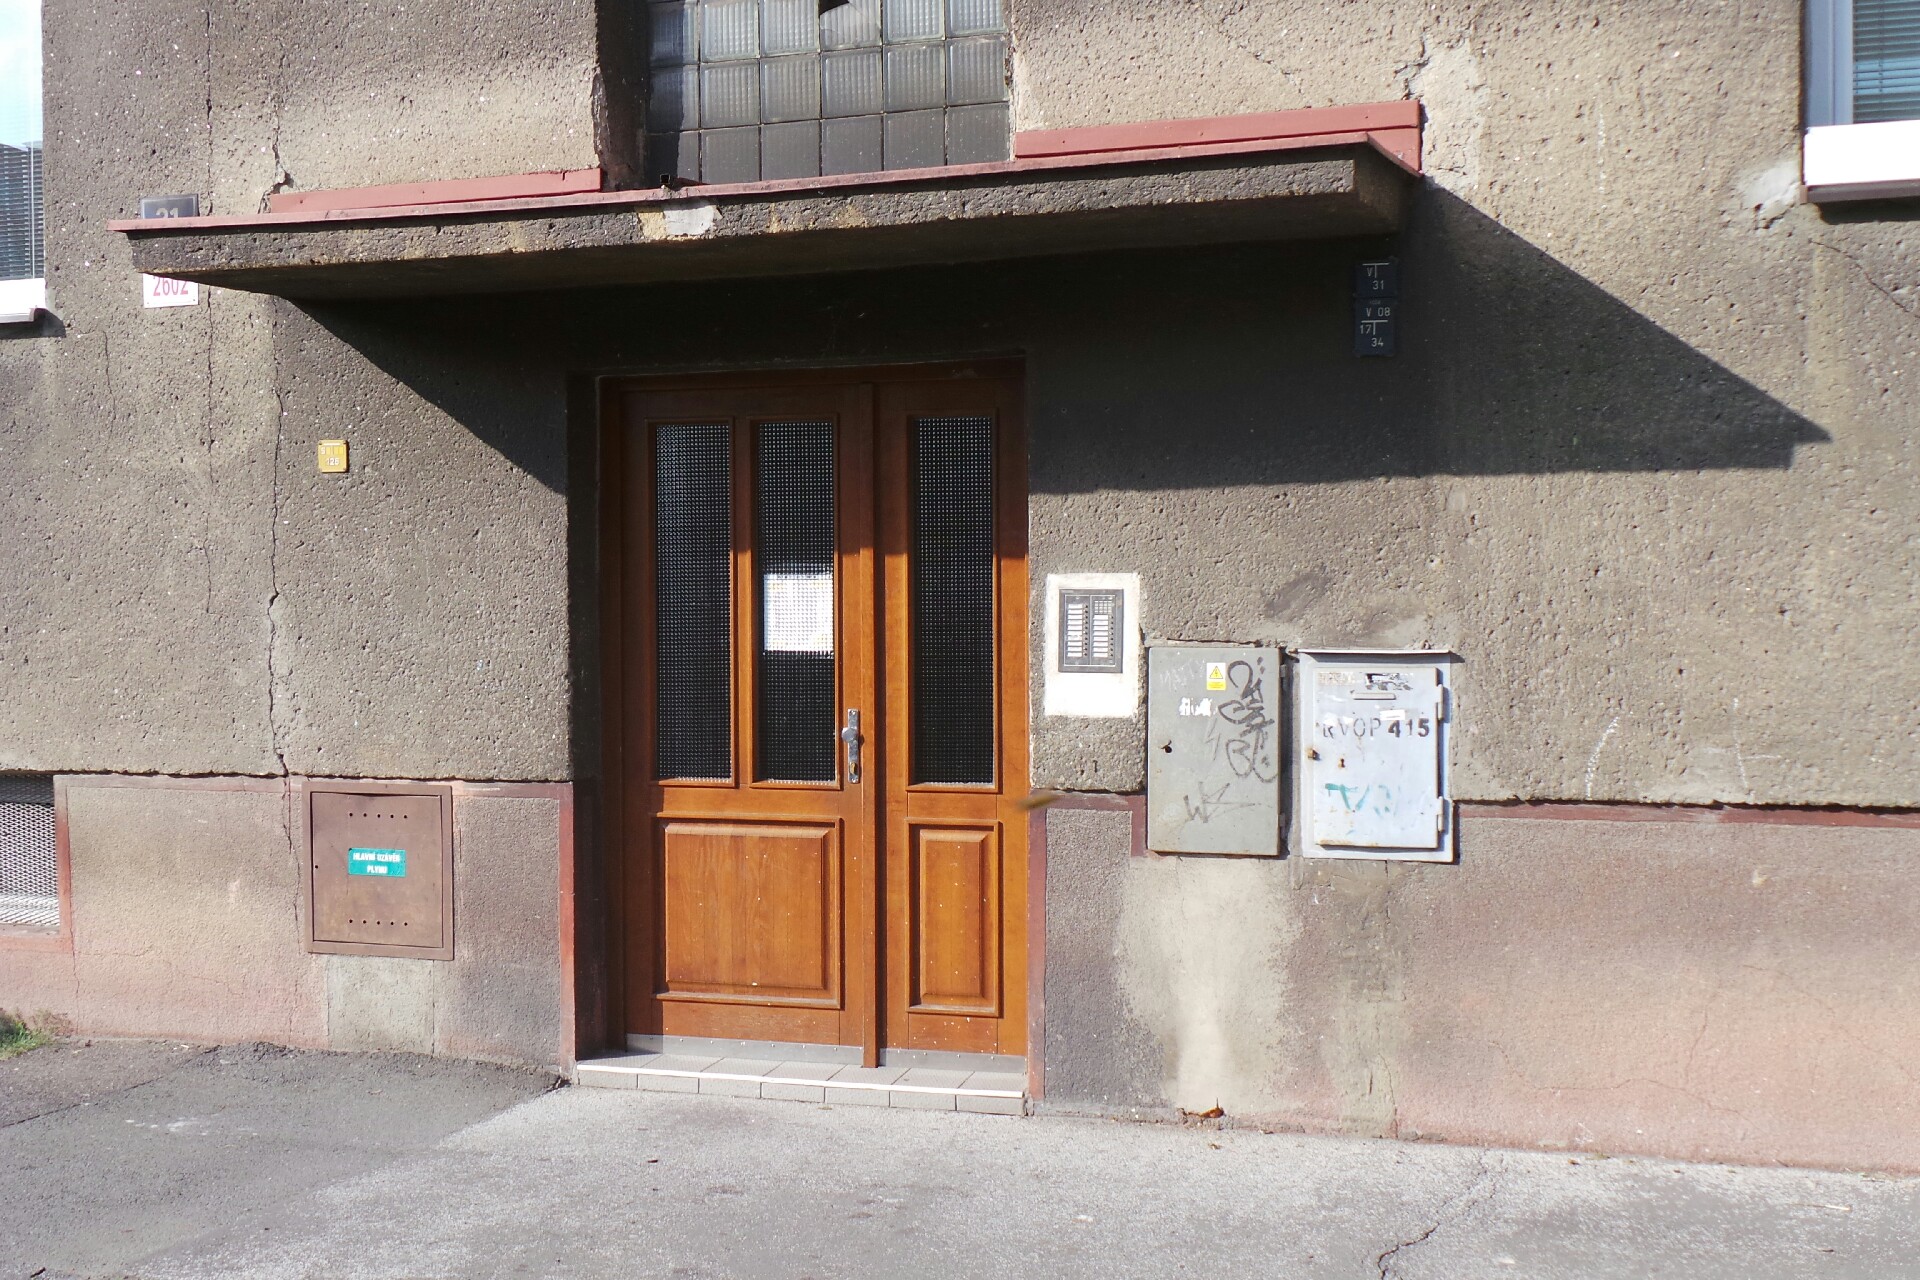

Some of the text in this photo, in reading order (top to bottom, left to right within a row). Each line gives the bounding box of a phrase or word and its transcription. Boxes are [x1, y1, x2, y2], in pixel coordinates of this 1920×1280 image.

[1372, 280, 1385, 290] 31
[1365, 307, 1391, 317] V 08
[1360, 324, 1372, 335] 17
[1371, 337, 1384, 347] 34
[1387, 717, 1430, 738] 415
